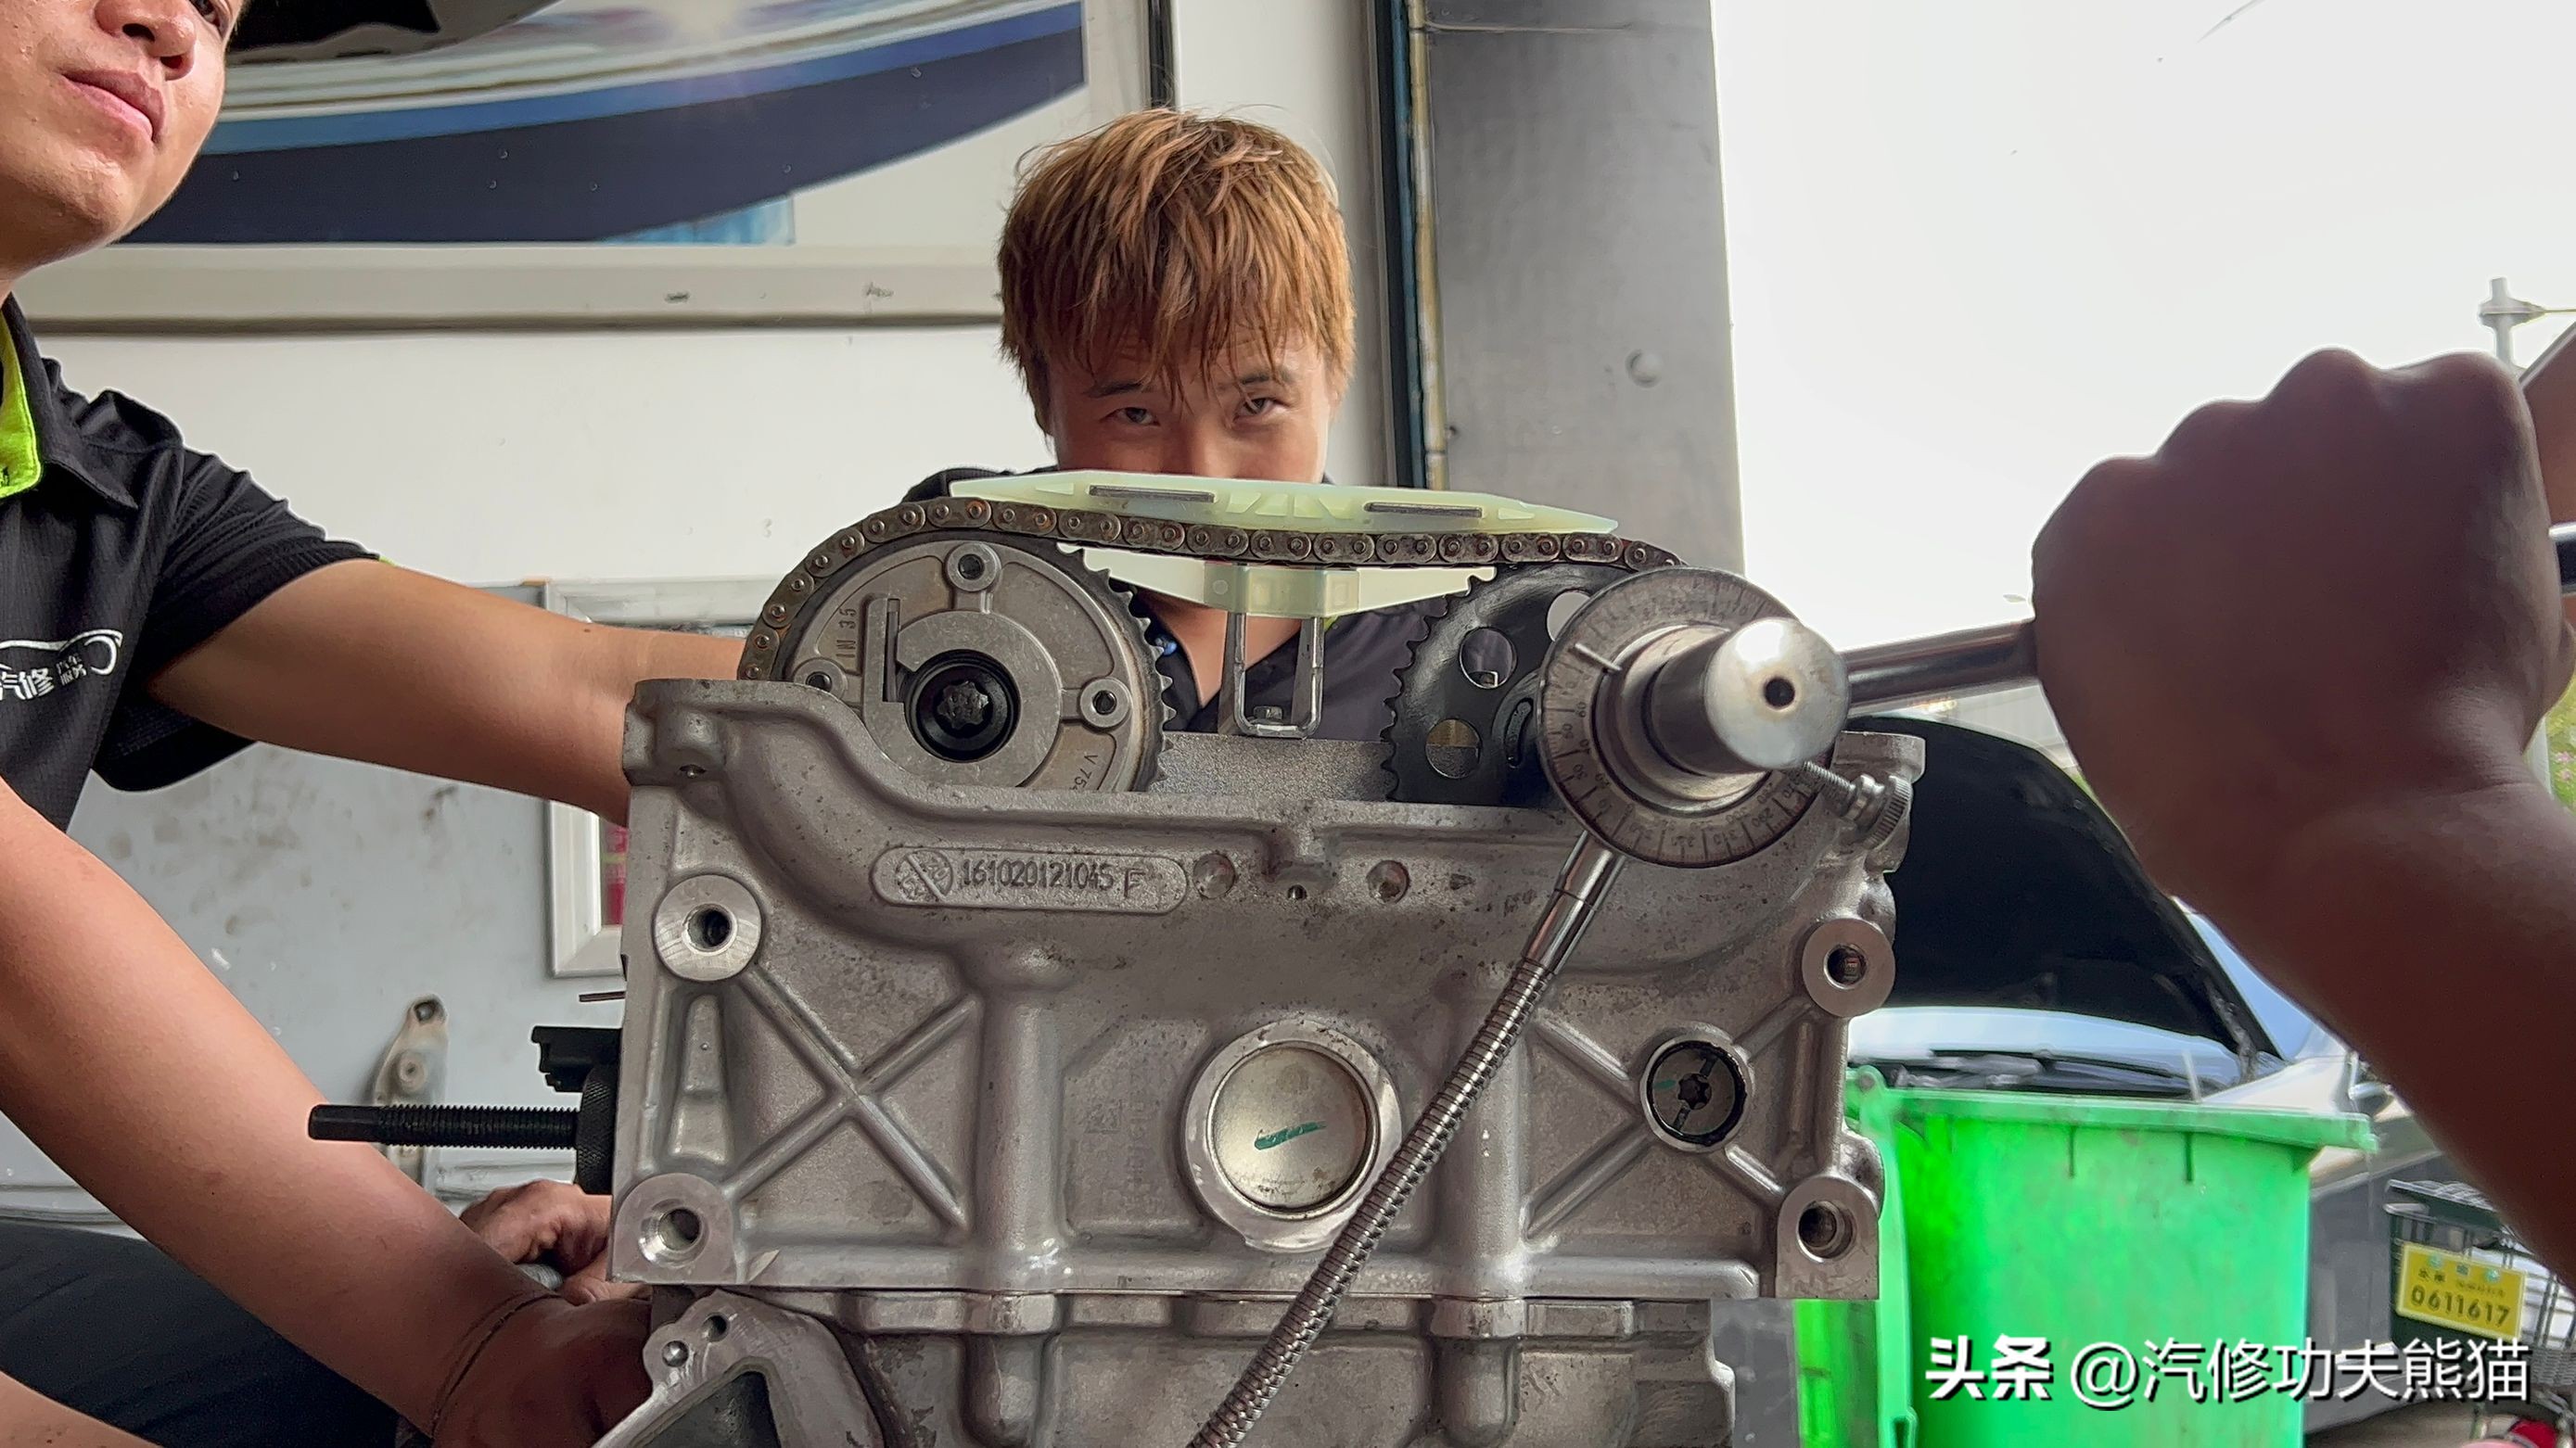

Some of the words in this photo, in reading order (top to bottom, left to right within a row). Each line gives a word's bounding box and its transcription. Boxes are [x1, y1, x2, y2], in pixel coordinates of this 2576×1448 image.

[838, 608, 857, 629] 35
[1123, 868, 1146, 898] F
[2411, 1285, 2510, 1328] 0611617
